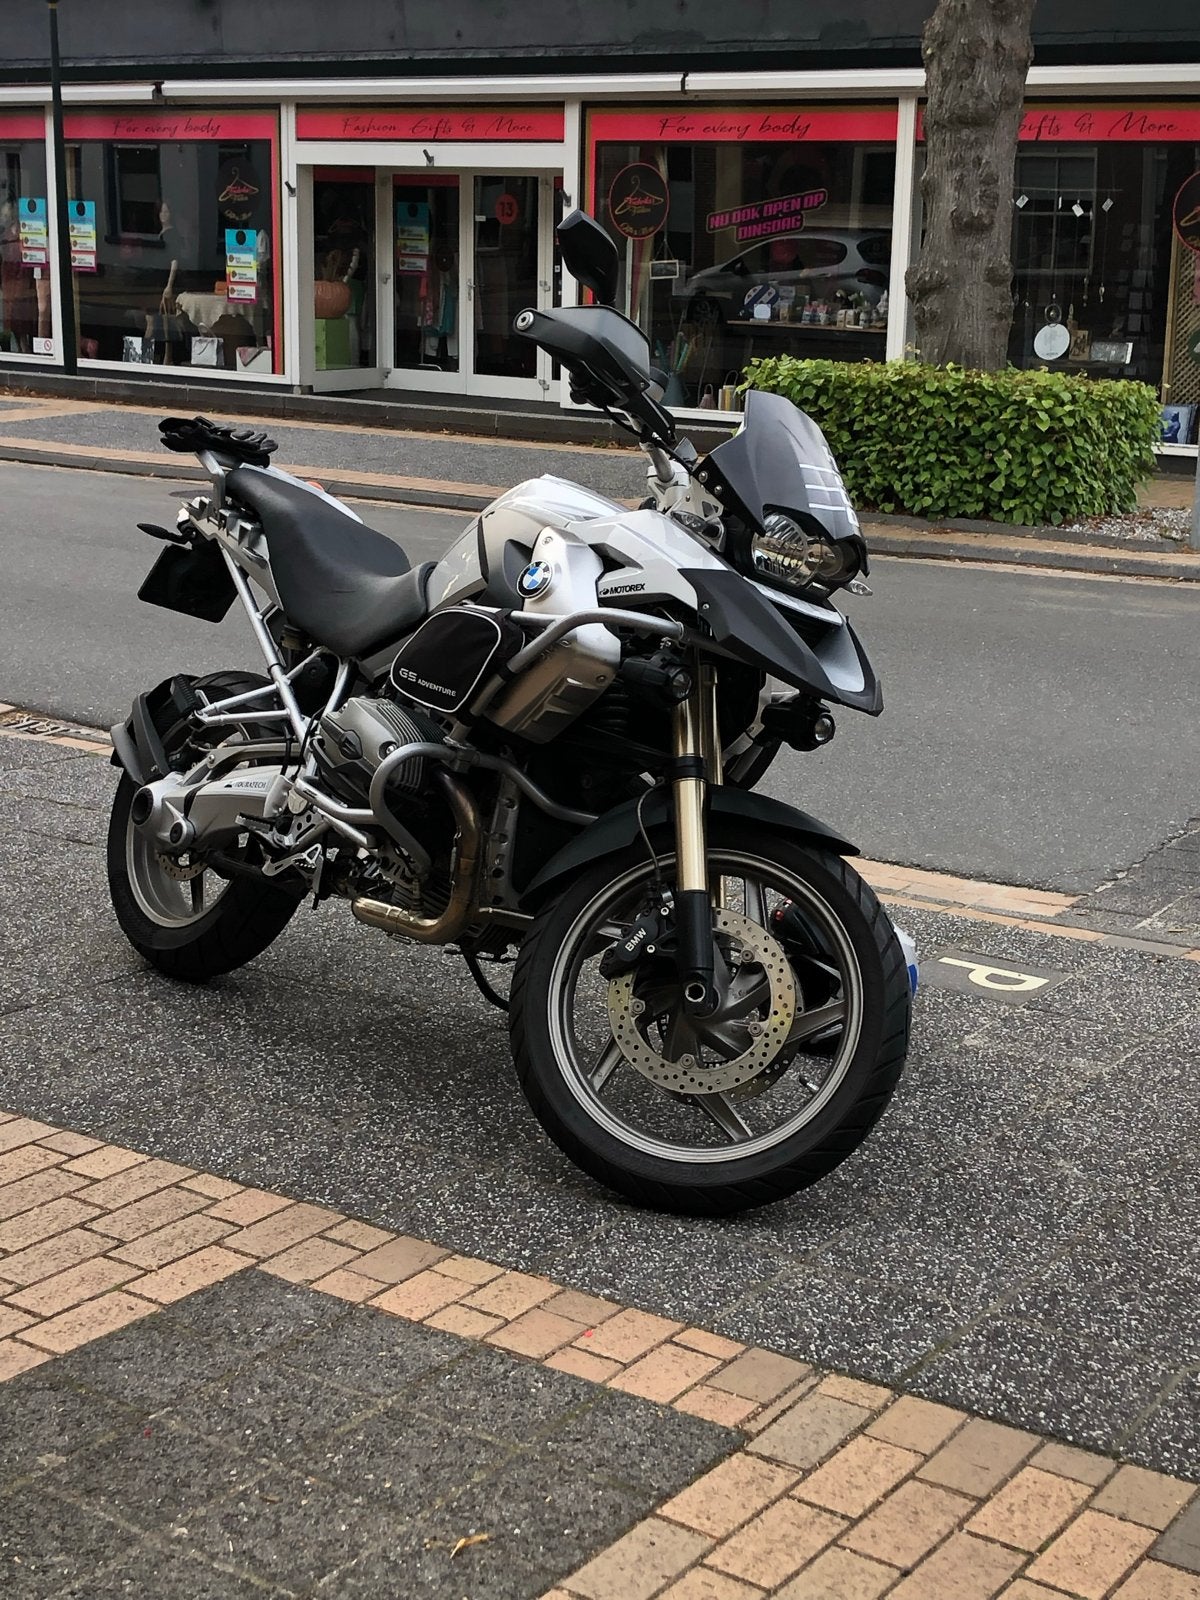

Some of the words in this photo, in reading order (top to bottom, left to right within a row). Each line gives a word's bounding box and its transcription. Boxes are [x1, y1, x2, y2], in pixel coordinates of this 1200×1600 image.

[113, 119, 139, 136] For
[144, 125, 178, 137] every
[183, 118, 220, 137] body
[342, 116, 397, 134] Fashion
[409, 117, 453, 139] Gifts
[461, 116, 475, 133] &
[659, 116, 694, 136] For
[702, 121, 751, 139] every
[758, 115, 811, 138] body
[1073, 112, 1095, 134] &
[500, 201, 513, 217] 13
[709, 212, 729, 229] NU
[731, 207, 760, 224] OOK
[762, 198, 801, 217] OPEN
[803, 192, 825, 209] OP
[737, 214, 802, 240] DINSDAG
[609, 583, 646, 594] MOTOREX
[399, 667, 418, 682] GS
[417, 678, 457, 697] ADVENTURE
[624, 927, 647, 952] BMW
[938, 956, 1050, 992] P
